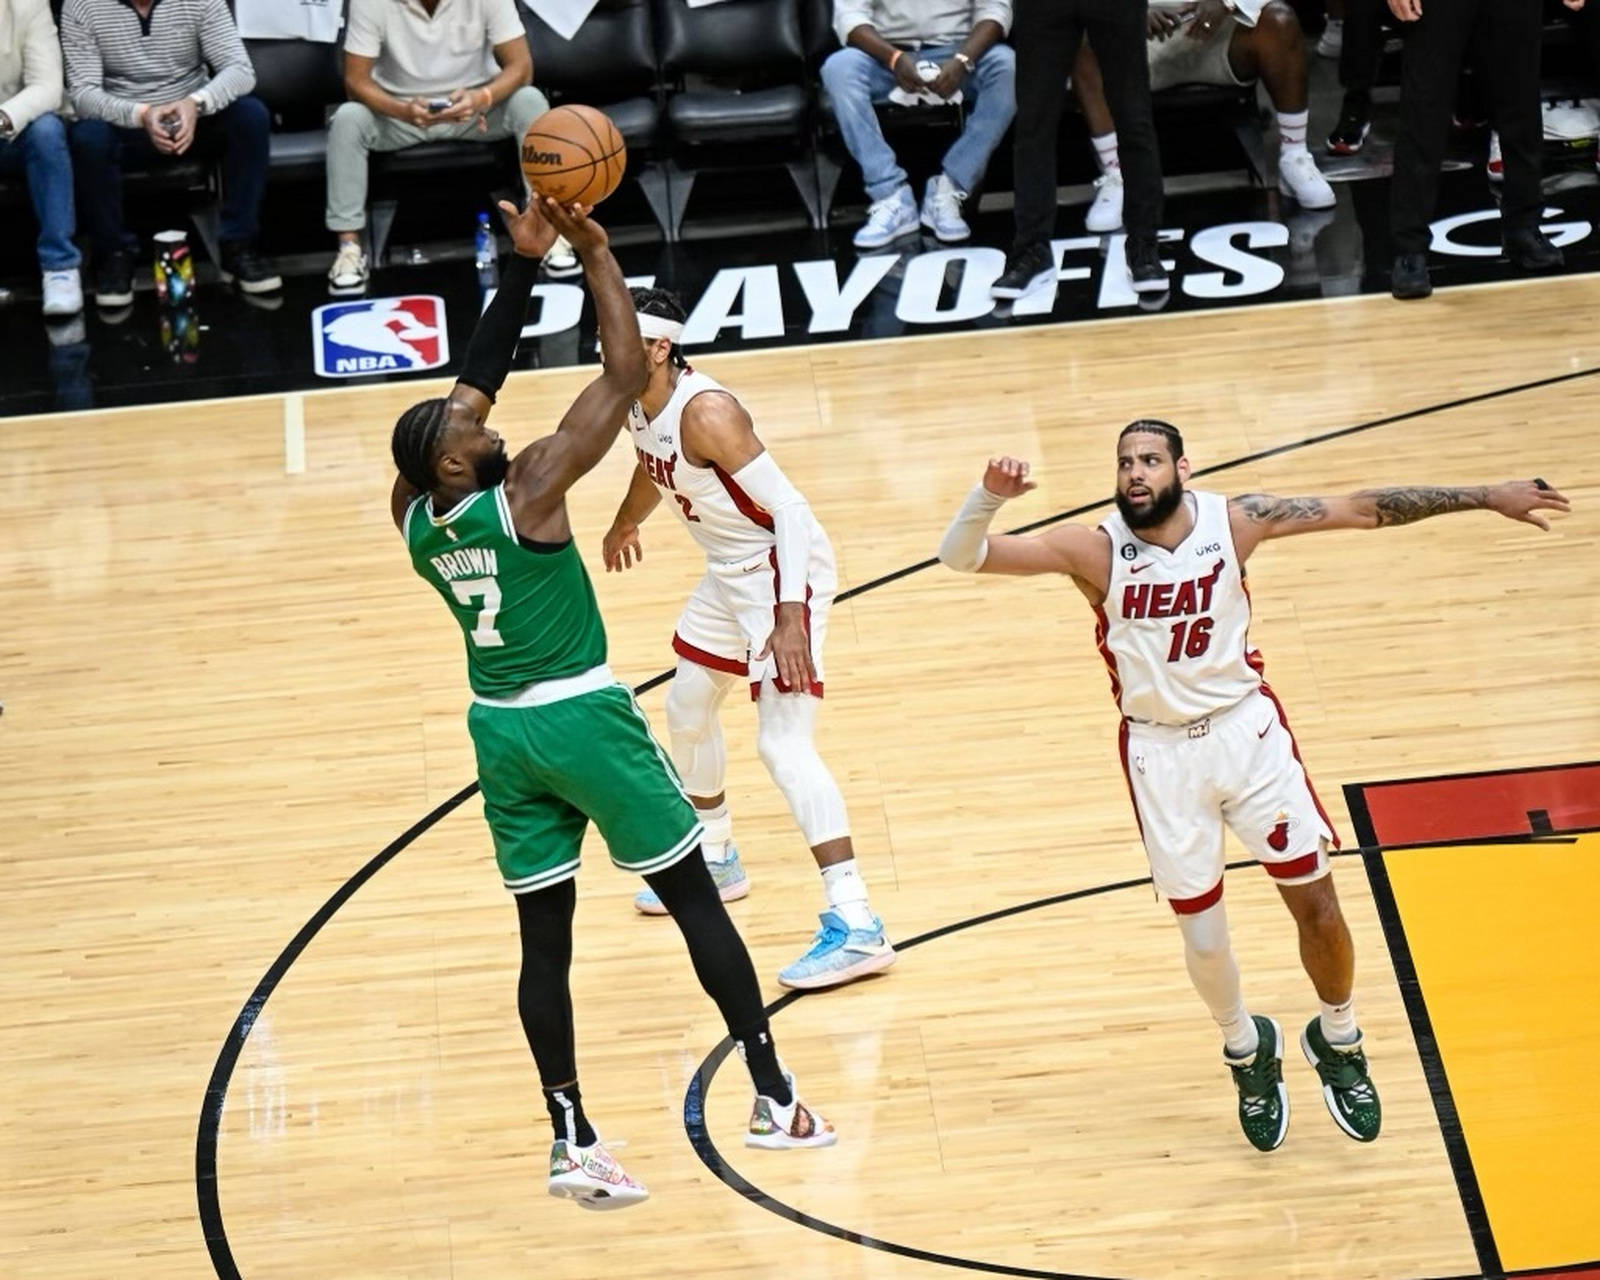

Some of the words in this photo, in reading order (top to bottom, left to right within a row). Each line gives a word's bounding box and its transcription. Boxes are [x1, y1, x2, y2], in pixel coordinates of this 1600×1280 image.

[521, 144, 562, 166] ilson
[477, 221, 1289, 359] PAYOFFS
[336, 355, 398, 372] NBA
[675, 493, 701, 522] 2
[430, 548, 498, 581] BROWN
[1122, 544, 1136, 559] 6
[1196, 543, 1221, 556] UKG
[1122, 558, 1226, 619] HEAT
[450, 576, 505, 647] 7
[1167, 617, 1215, 662] 16
